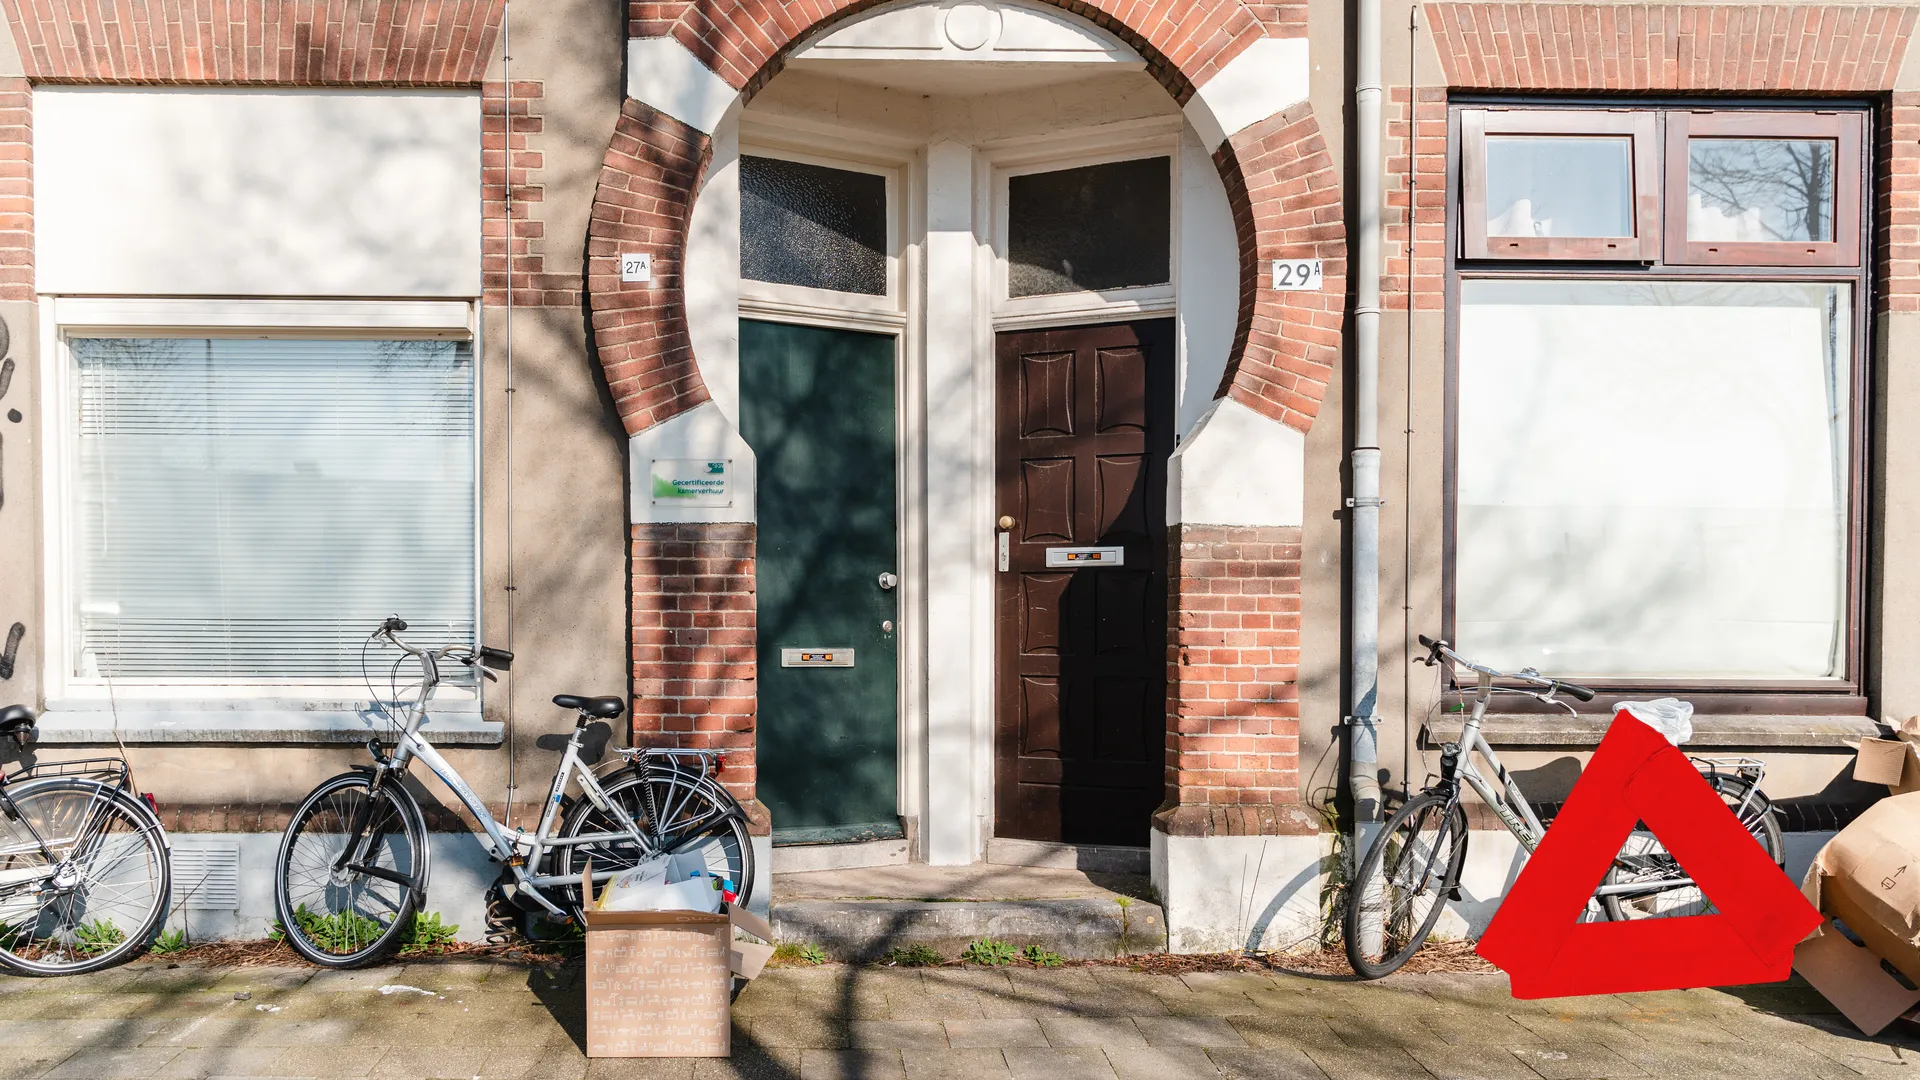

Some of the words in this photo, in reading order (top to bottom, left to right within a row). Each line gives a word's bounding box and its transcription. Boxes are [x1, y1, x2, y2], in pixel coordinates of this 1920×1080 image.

[626, 261, 646, 274] 27A
[1279, 261, 1320, 286] 29A
[677, 487, 724, 495] kamerverhuur
[1499, 802, 1539, 853] TREK
